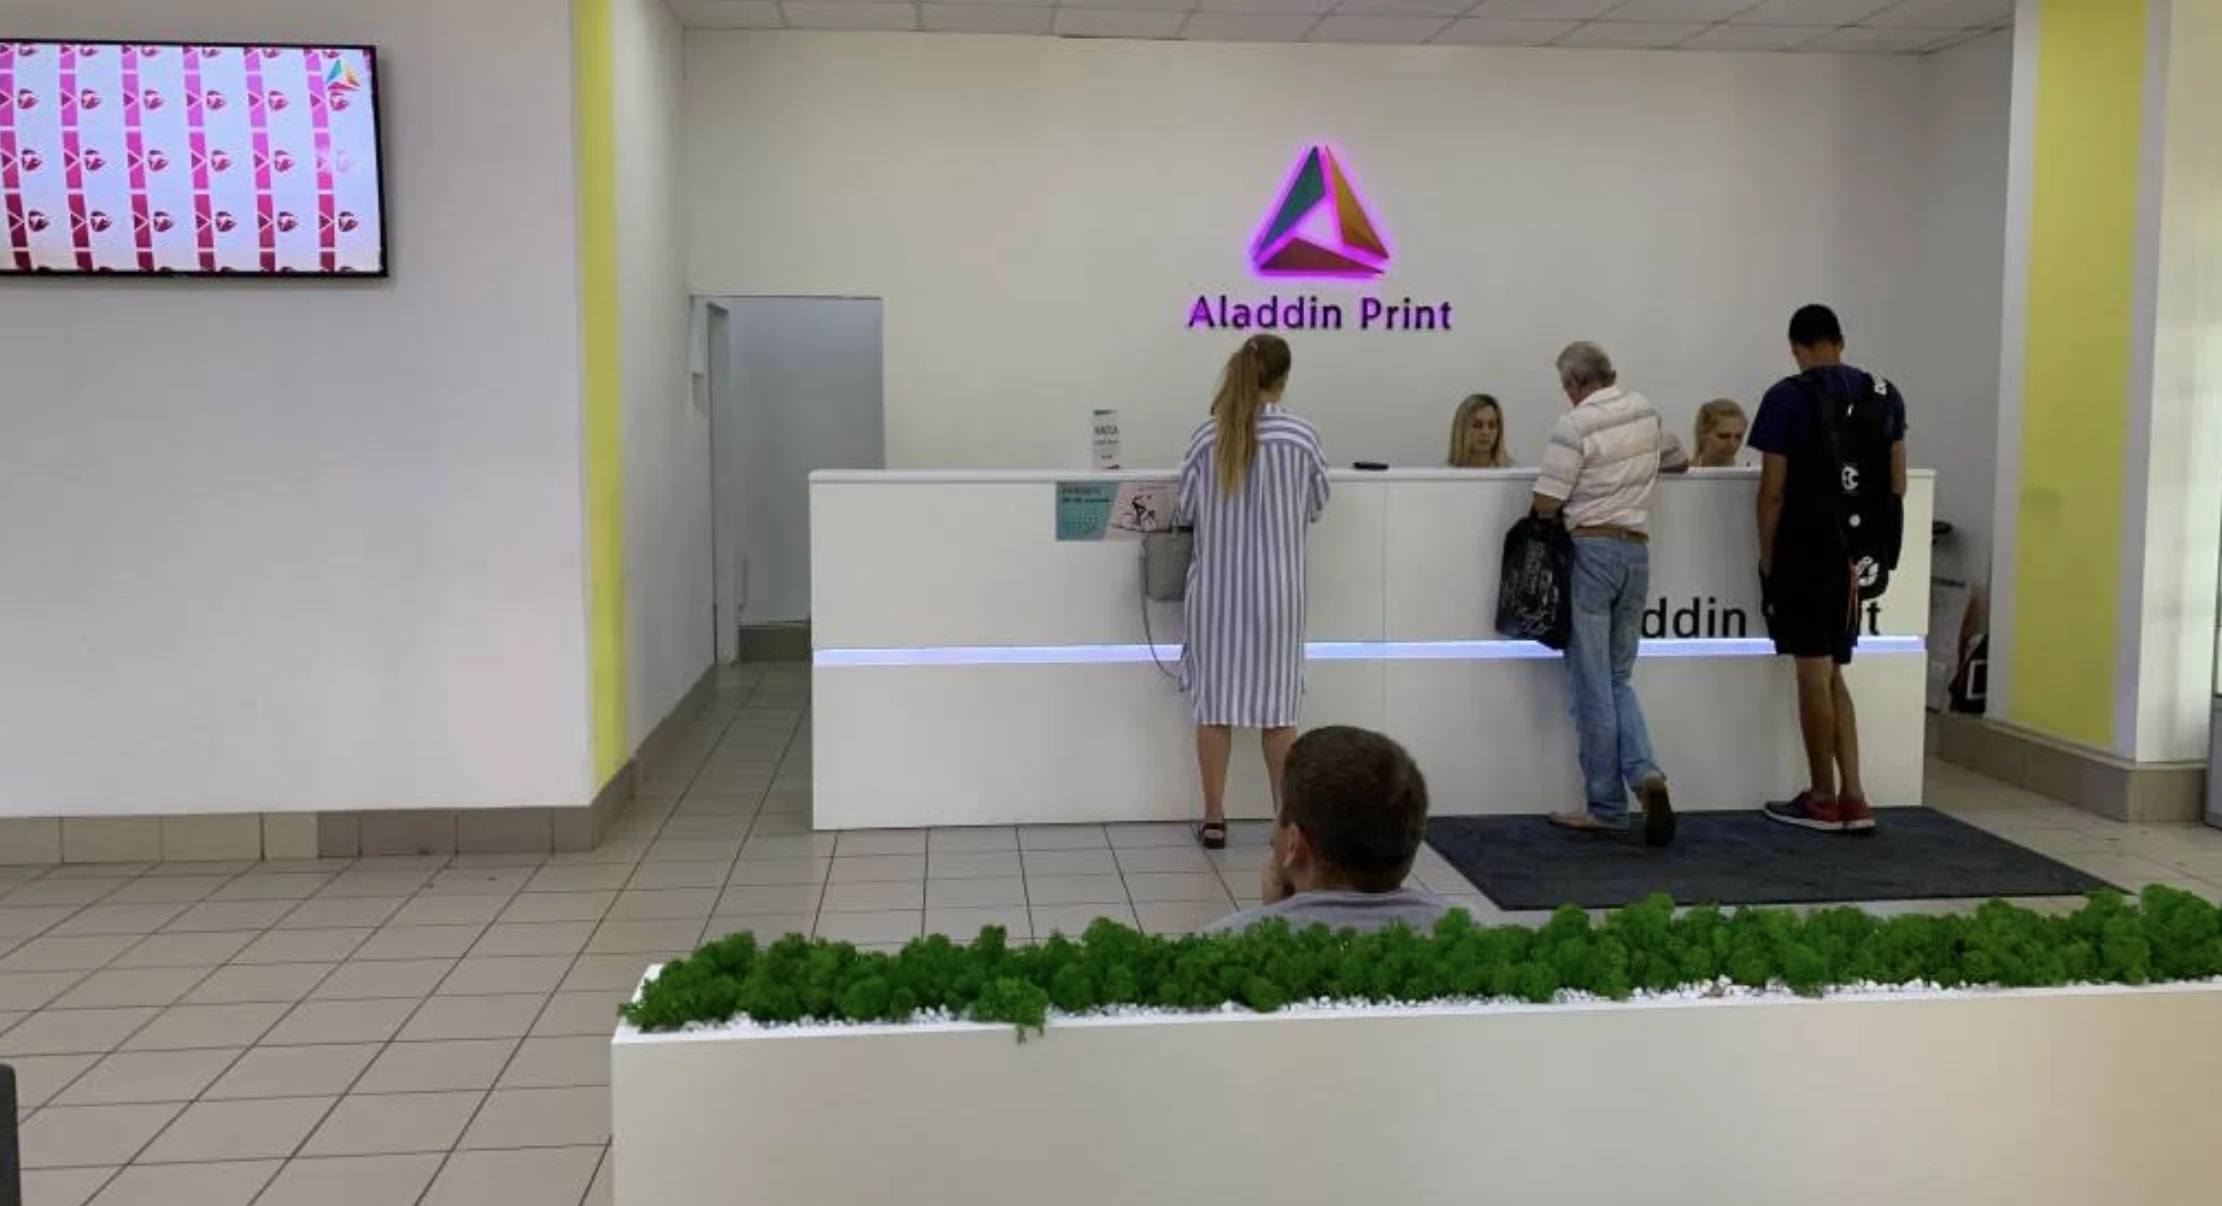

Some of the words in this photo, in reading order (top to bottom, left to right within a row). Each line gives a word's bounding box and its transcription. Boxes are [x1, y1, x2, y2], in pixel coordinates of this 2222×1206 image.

[1187, 294, 1342, 330] Aladdin
[1361, 297, 1453, 330] Print
[1640, 596, 1747, 638] ddin
